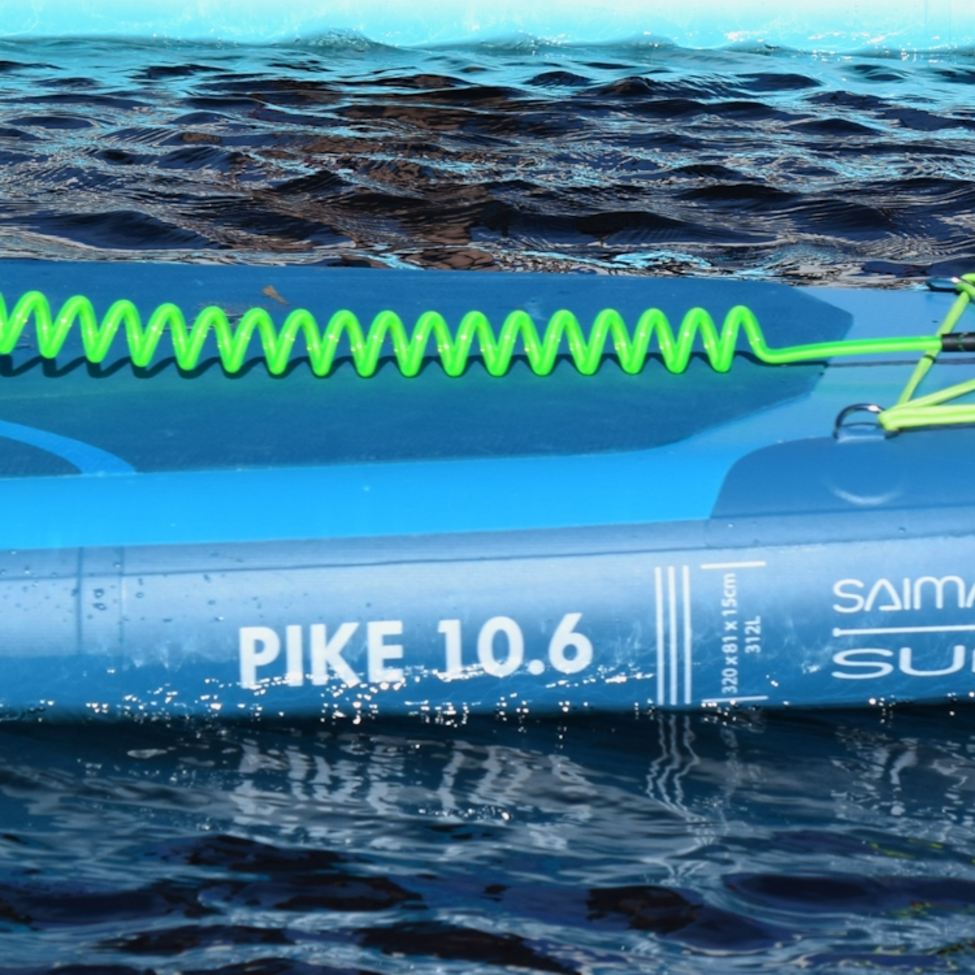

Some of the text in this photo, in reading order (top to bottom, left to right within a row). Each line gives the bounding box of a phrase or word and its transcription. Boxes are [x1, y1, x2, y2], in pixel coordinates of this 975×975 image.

[239, 612, 594, 690] PIKE 10.6
[720, 572, 739, 695] 320 x 81 x 15cm
[744, 615, 762, 654] 312L
